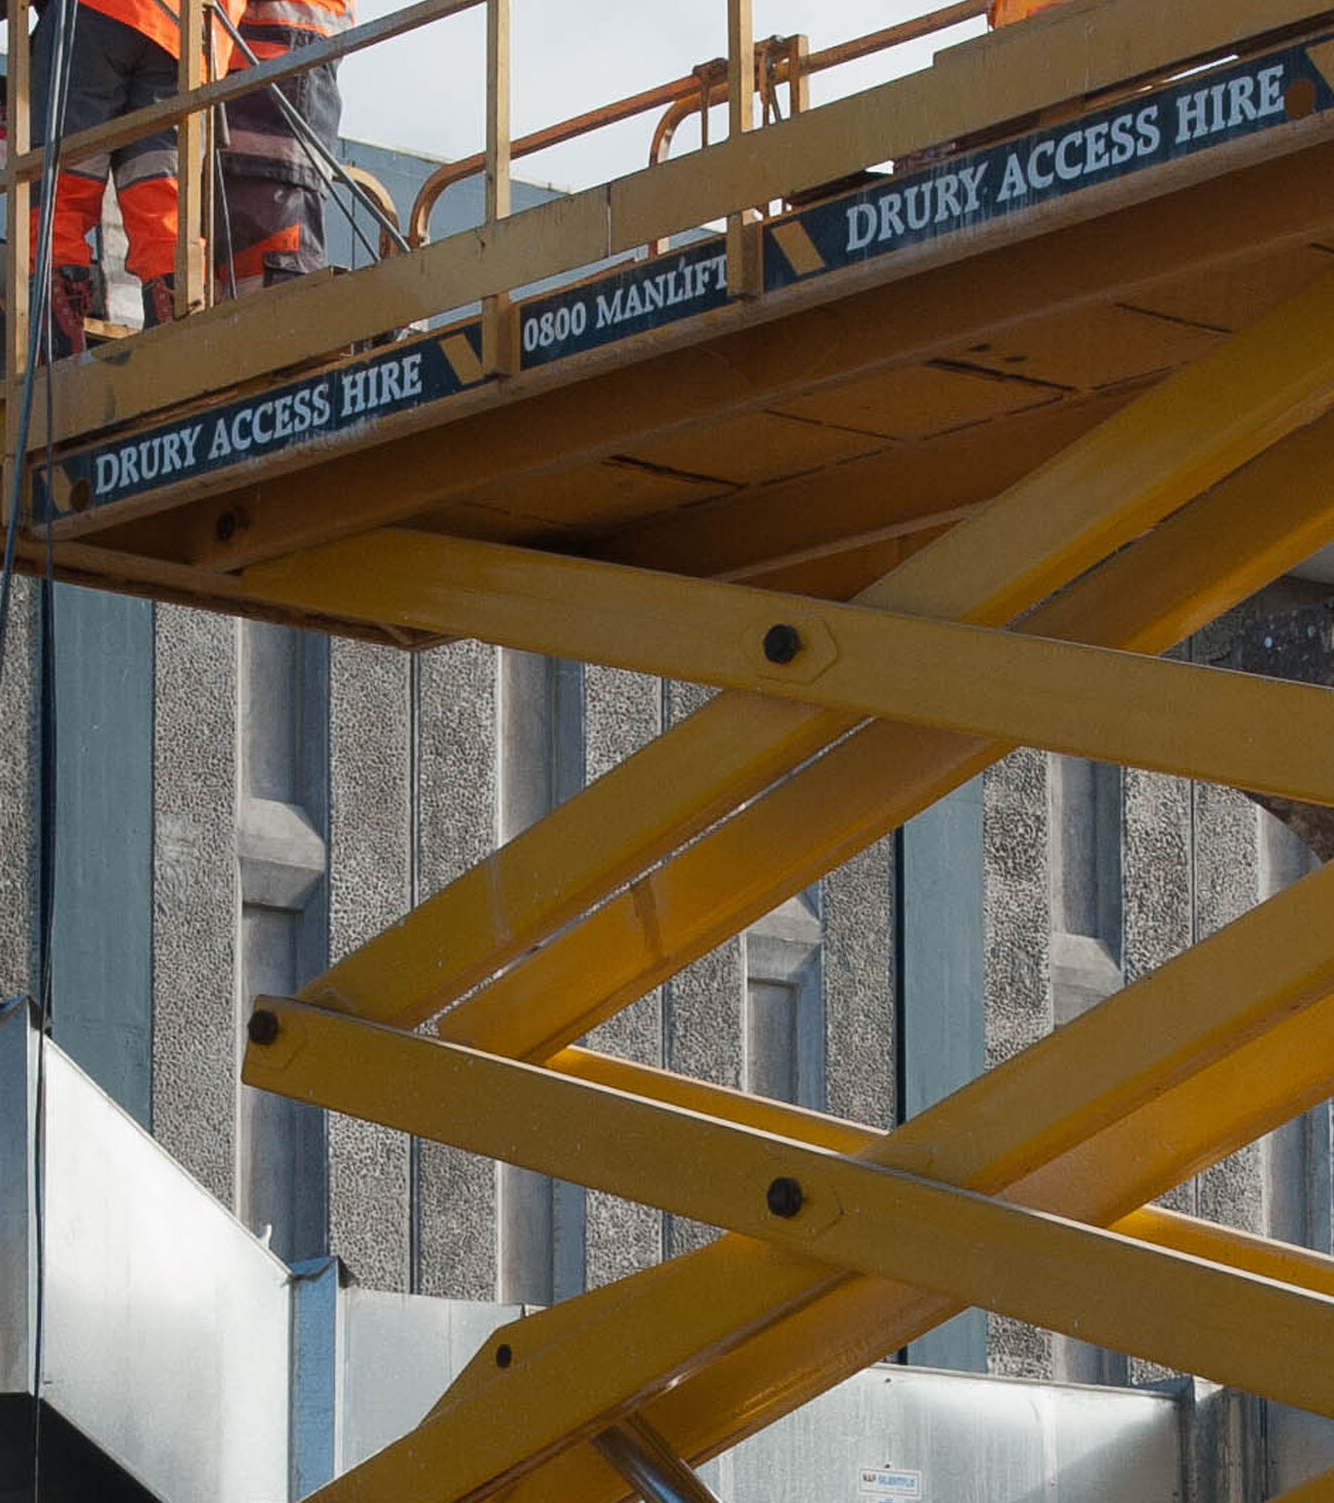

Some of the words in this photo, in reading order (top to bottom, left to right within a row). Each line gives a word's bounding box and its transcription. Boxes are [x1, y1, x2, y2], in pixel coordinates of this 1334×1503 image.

[845, 163, 989, 253] DRURY
[997, 105, 1161, 201] ACCESS
[1174, 63, 1286, 144] HIRE
[523, 301, 587, 351] 0800
[595, 254, 728, 329] MANLIFT
[94, 424, 204, 496] DRURY
[207, 381, 331, 461] ACCESS
[340, 353, 424, 417] HIRE
